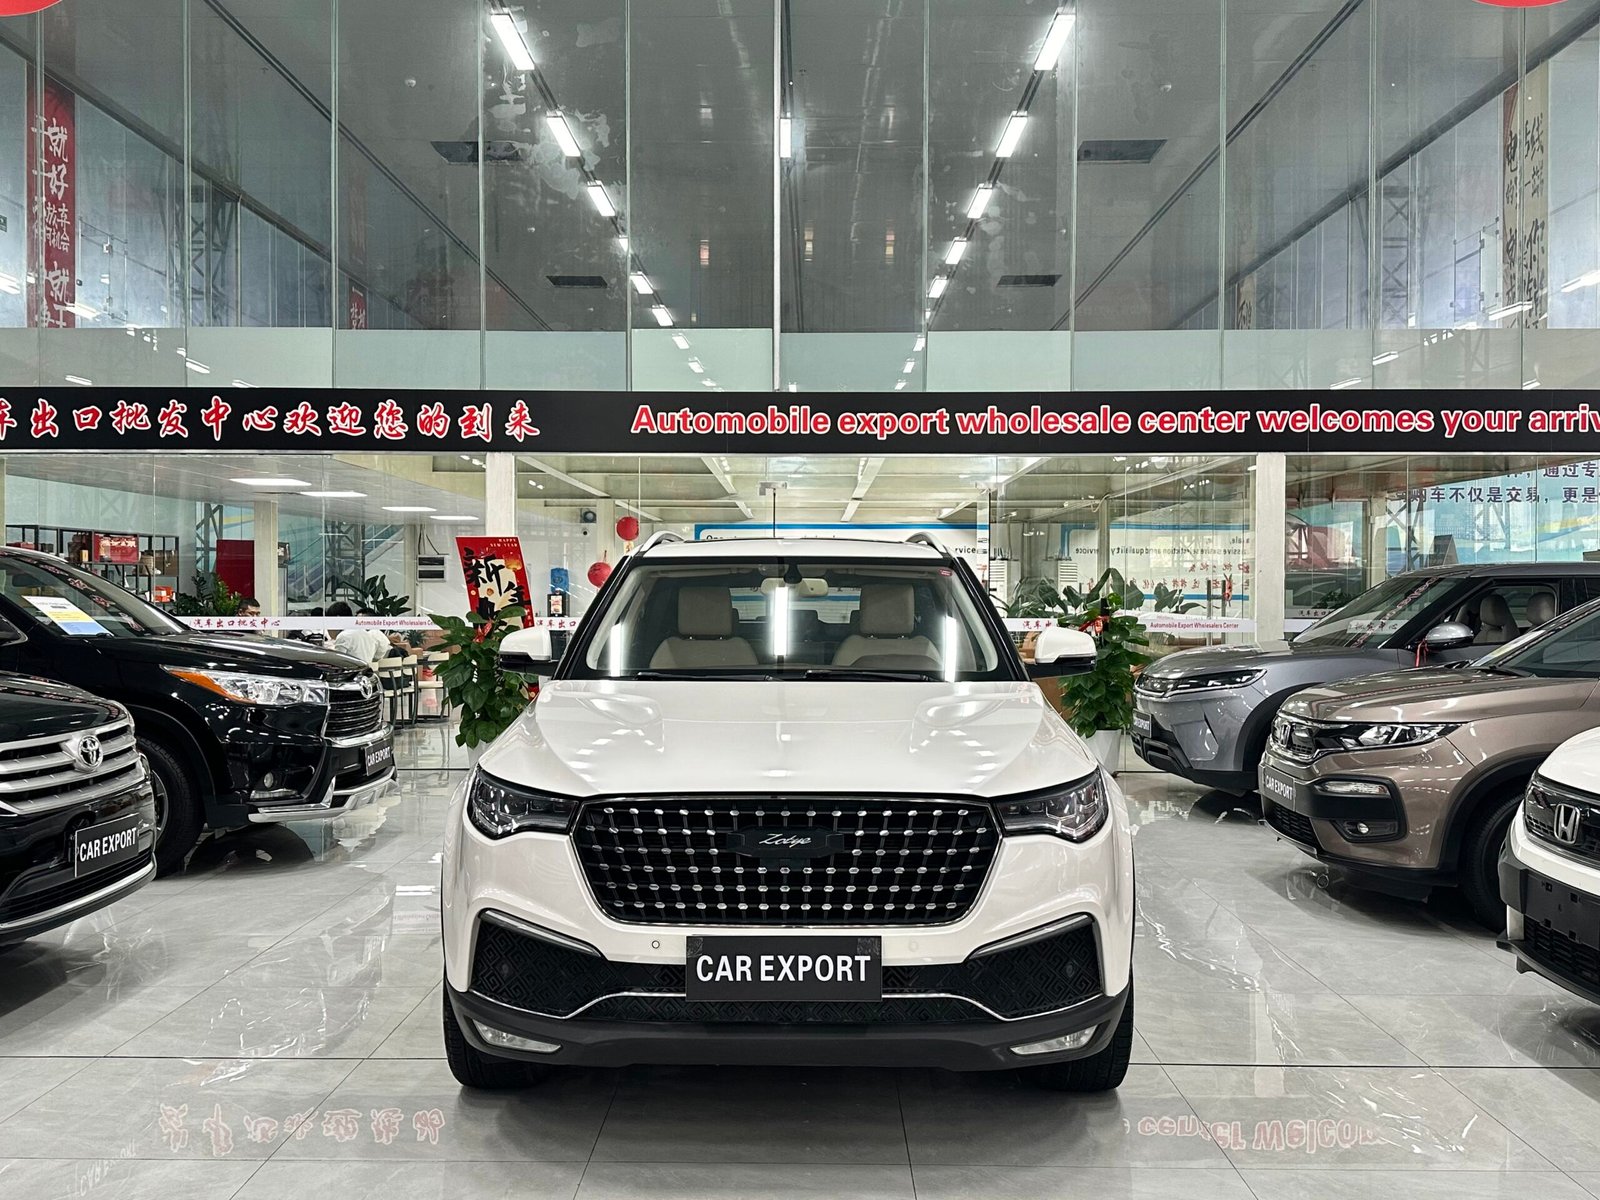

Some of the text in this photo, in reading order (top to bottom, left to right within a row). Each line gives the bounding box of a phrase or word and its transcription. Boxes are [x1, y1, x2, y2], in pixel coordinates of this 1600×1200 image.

[631, 404, 831, 434] Automobile
[837, 408, 949, 440] export
[956, 406, 1131, 434] wholesale
[1138, 407, 1250, 433] center
[1256, 404, 1434, 432] welcomes
[1443, 408, 1522, 438] your
[193, 618, 281, 629] 汽车出口批发中心
[1178, 622, 1194, 630] Export
[1265, 774, 1293, 800] CAR EXPORT
[79, 827, 137, 862] CAR EXPORT
[696, 955, 871, 982] CAR EXPORT
